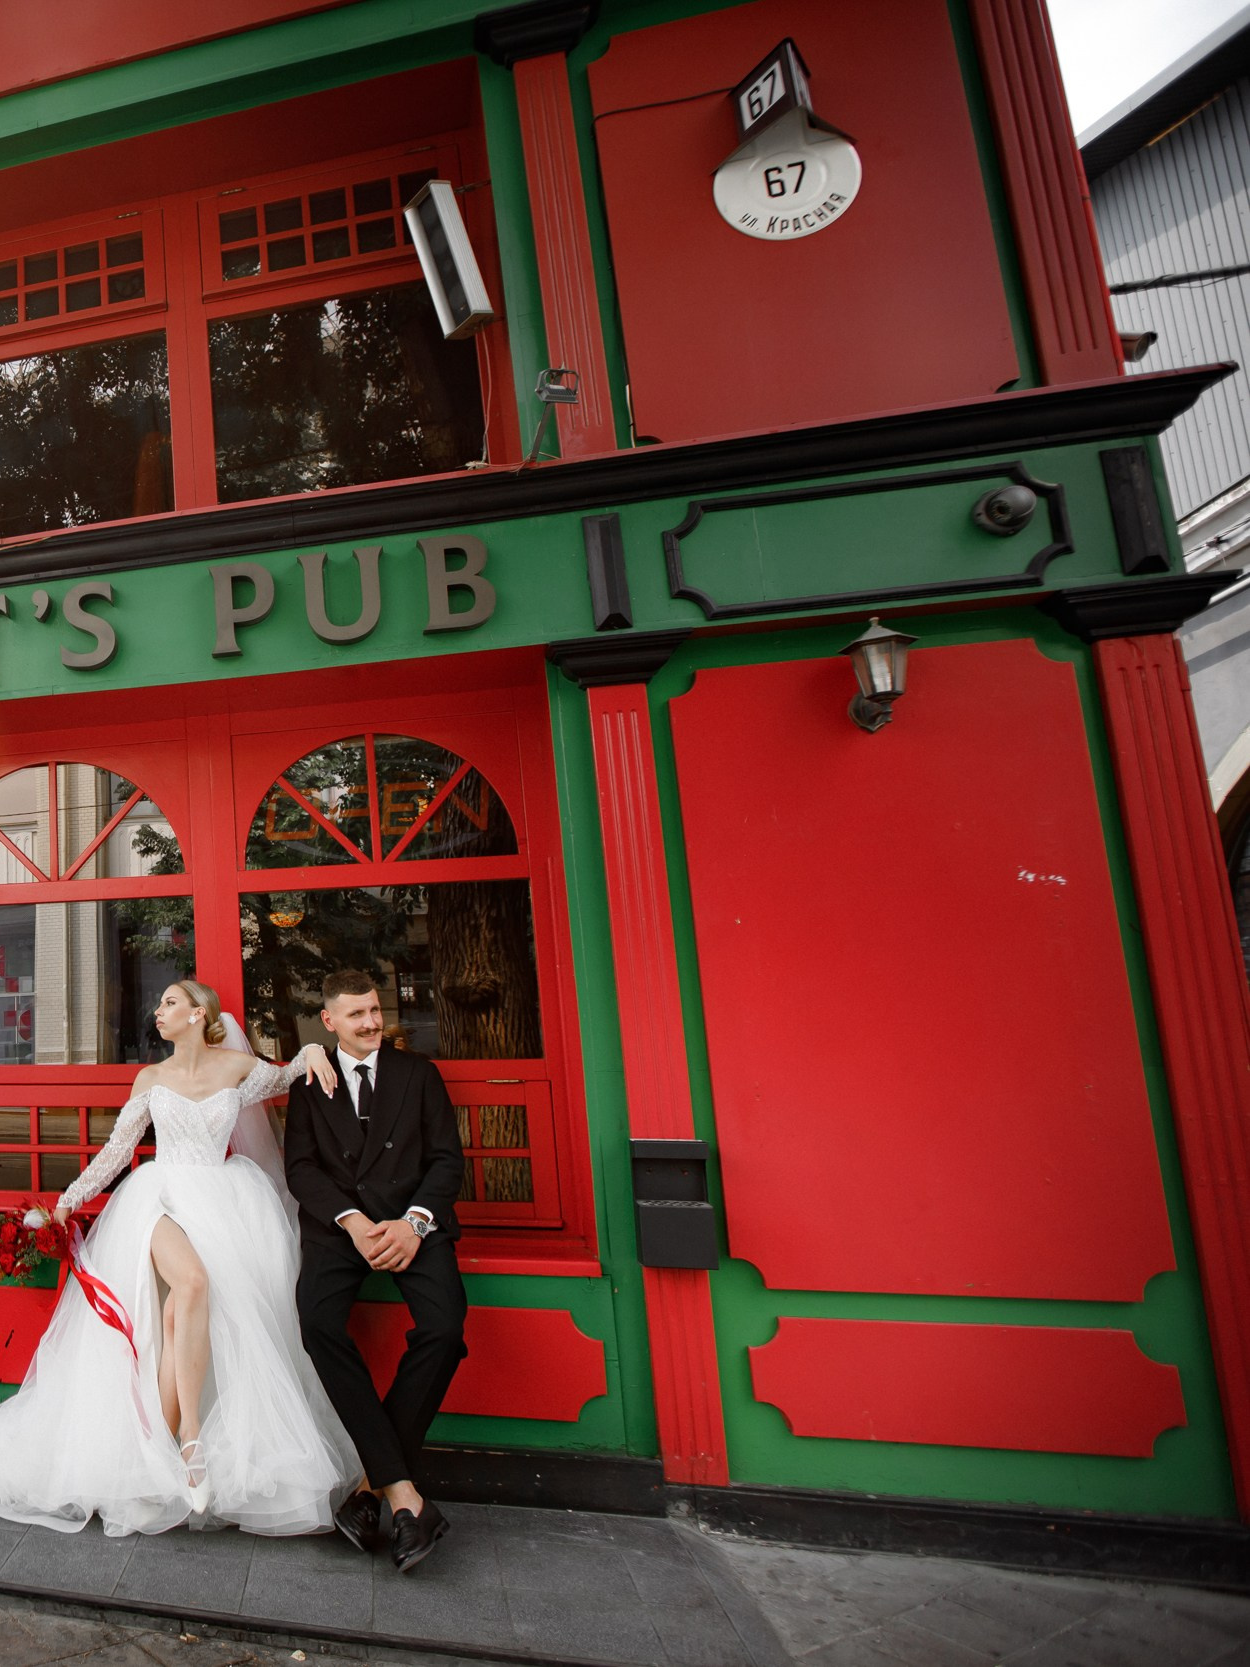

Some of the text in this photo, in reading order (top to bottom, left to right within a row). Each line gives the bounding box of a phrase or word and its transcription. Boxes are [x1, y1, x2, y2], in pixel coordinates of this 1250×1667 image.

[747, 68, 777, 121] 67
[763, 160, 806, 198] 67
[208, 533, 498, 659] PUB
